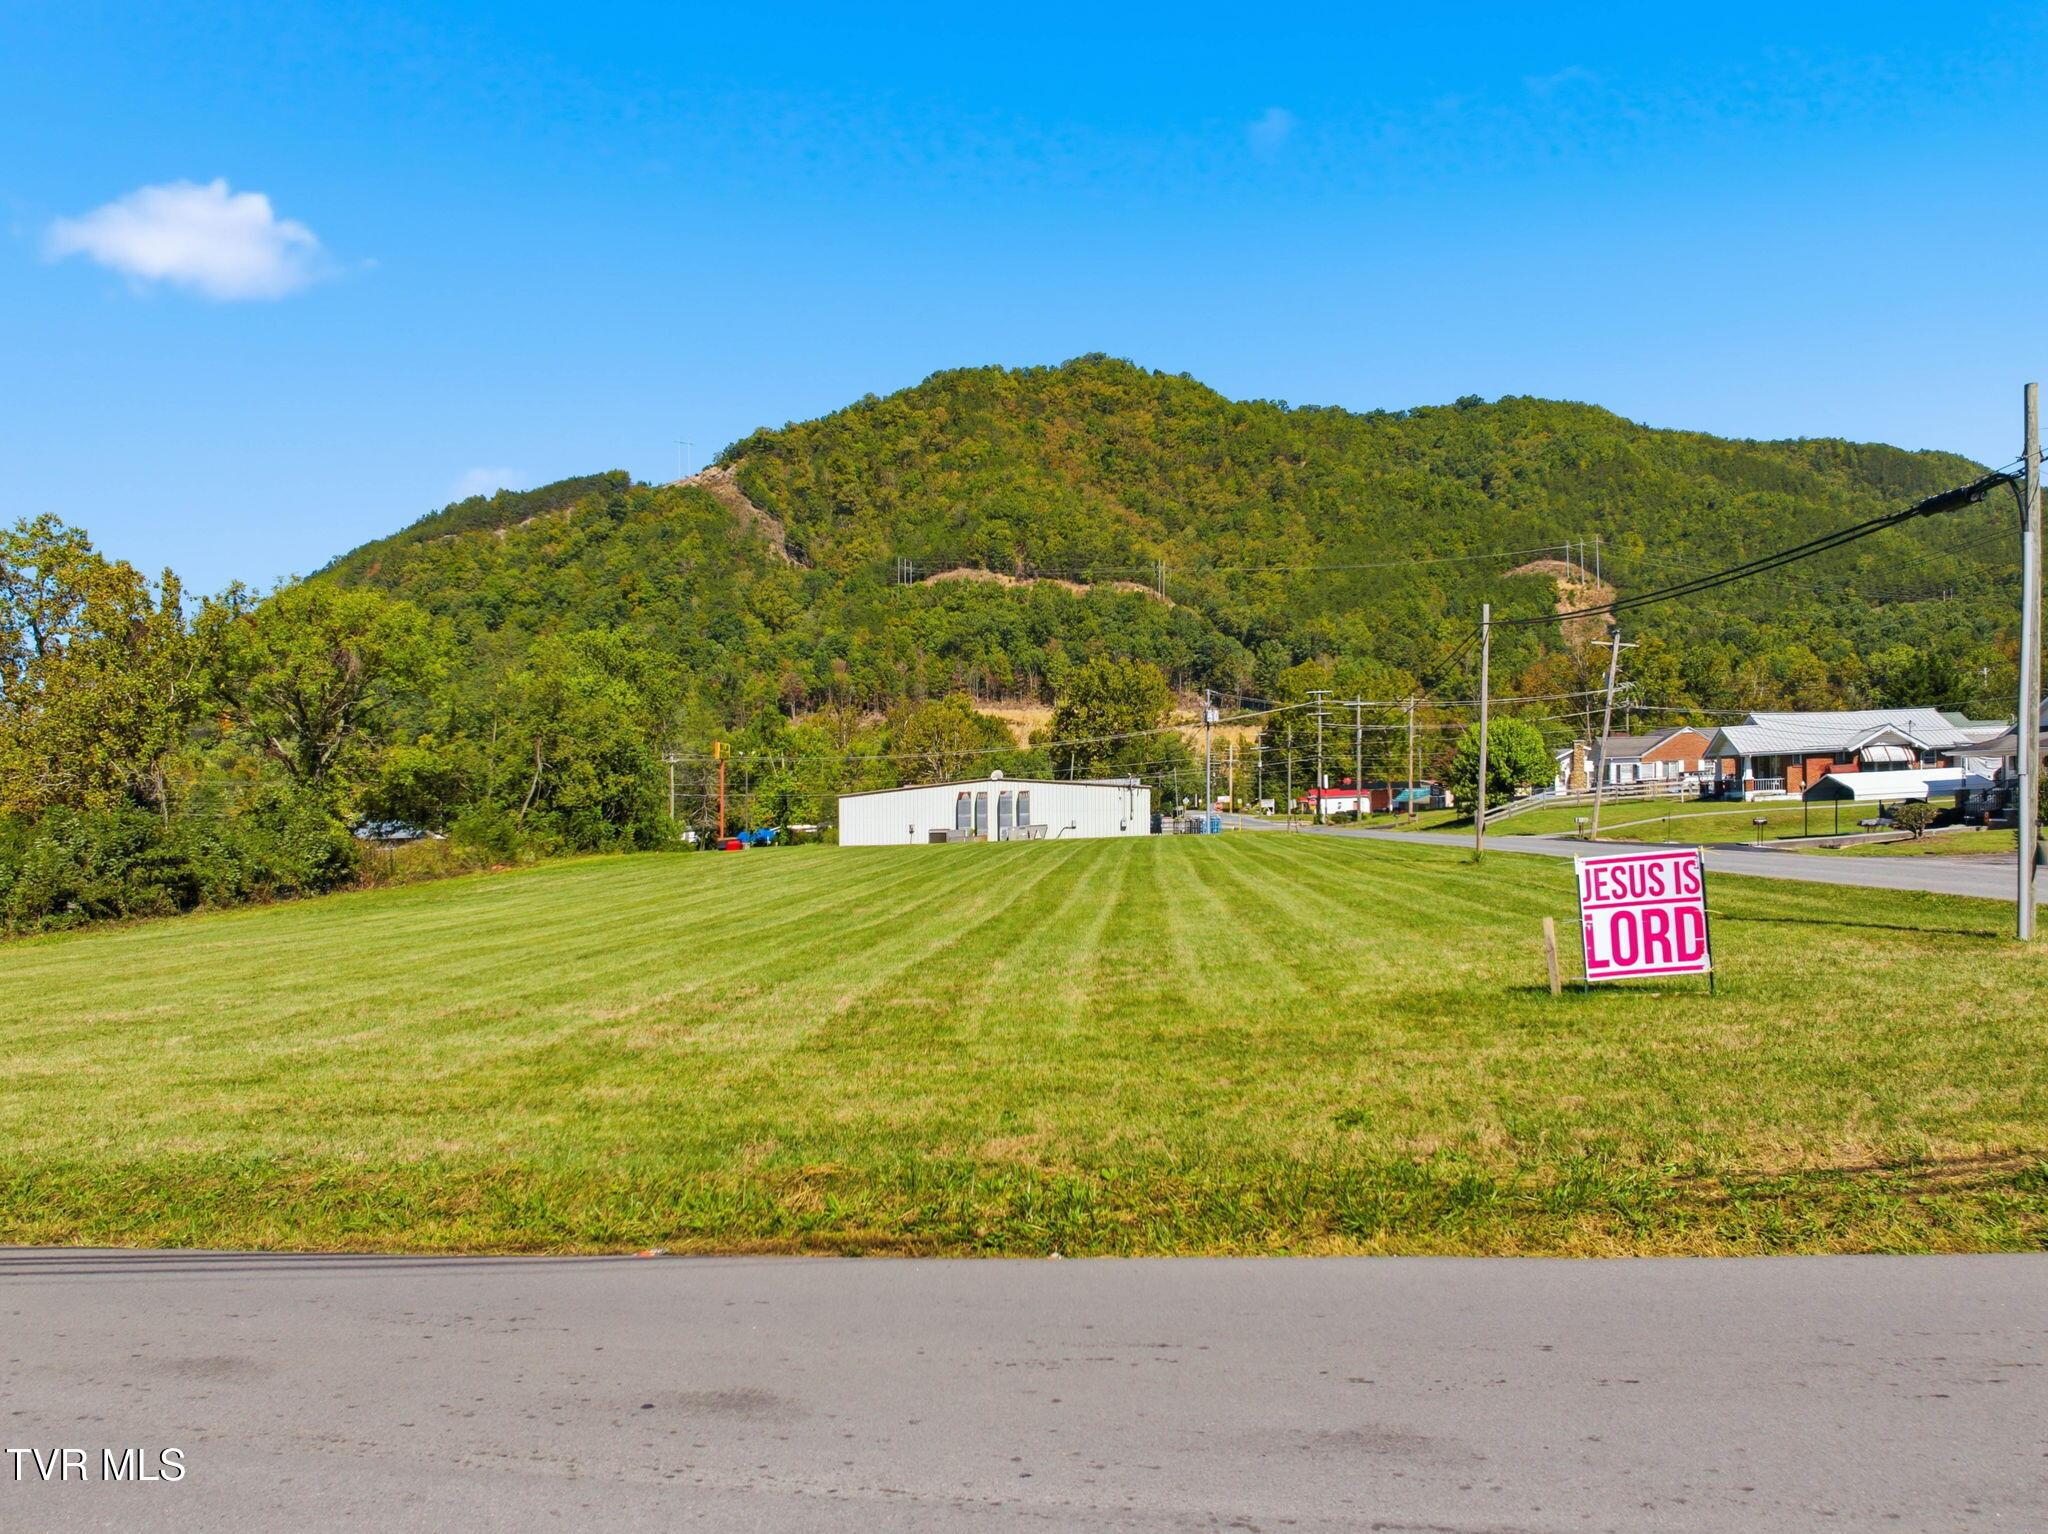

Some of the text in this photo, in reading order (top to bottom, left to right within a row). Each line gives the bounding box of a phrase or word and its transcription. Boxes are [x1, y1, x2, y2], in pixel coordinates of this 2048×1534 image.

[1583, 860, 1701, 902] JESUS IS
[1584, 906, 1705, 969] LORD
